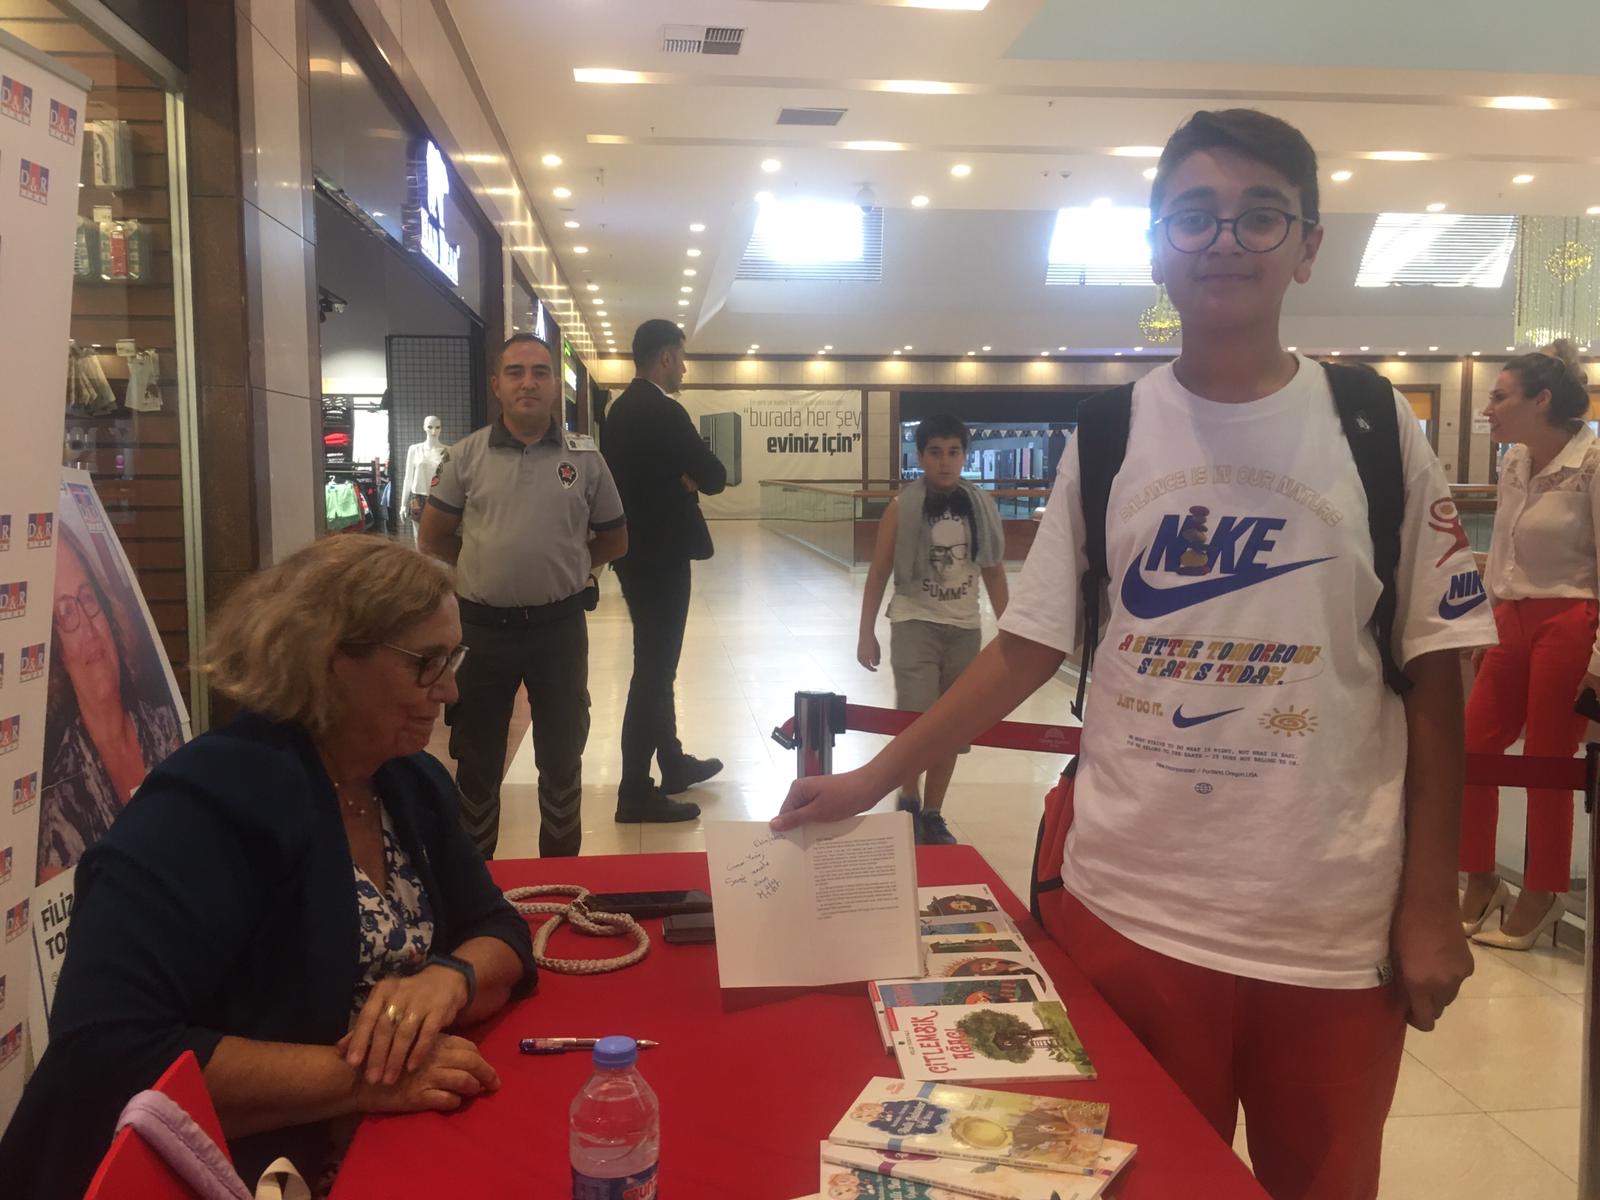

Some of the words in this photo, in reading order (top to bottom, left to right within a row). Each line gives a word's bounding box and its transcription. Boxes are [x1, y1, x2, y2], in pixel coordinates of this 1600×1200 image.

[0, 86, 32, 116] D&R
[49, 109, 77, 136] D&R
[21, 169, 48, 194] D&R
[806, 407, 832, 427] her
[835, 409, 861, 430] şey
[766, 432, 819, 454] eviniz
[1190, 466, 1208, 486] IS
[1212, 464, 1232, 485] IN
[1236, 466, 1276, 491] OUR
[1276, 475, 1344, 527] NATURE
[28, 521, 53, 541] D&R
[1448, 570, 1485, 601] NIK
[1118, 634, 1134, 651] A
[1132, 635, 1204, 659] BETTER
[1206, 641, 1322, 665] TOMORROW
[20, 655, 45, 674] D&R
[1137, 657, 1214, 681] STARTS
[1116, 694, 1135, 711] JUST
[1136, 699, 1150, 714] DO
[910, 1009, 957, 1073] ÇİTLEMBİK
